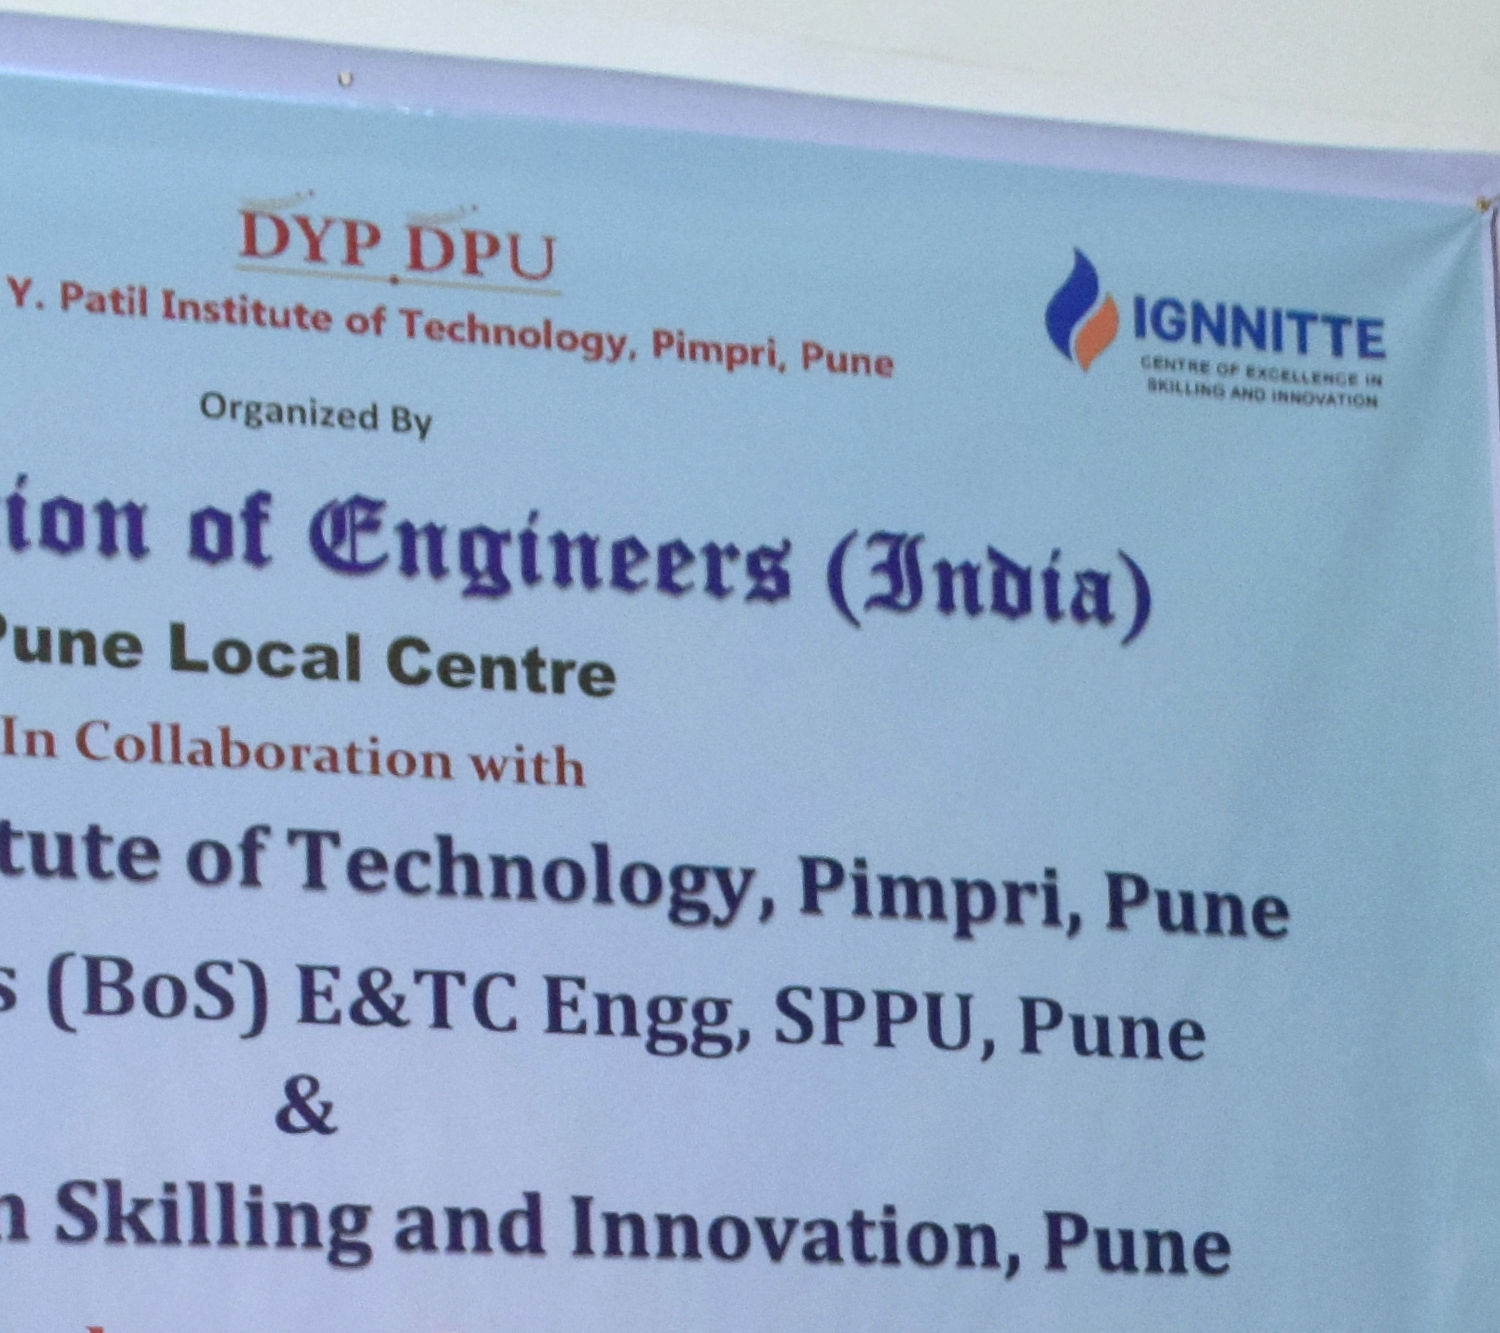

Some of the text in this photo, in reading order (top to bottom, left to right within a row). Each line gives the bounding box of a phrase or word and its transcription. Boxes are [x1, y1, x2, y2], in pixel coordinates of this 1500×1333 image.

[239, 209, 557, 281] DYP DPU
[7, 270, 46, 312] Y.
[59, 281, 149, 318] Patil
[161, 286, 331, 334] Institute
[345, 301, 388, 339] of
[399, 306, 639, 366] Technology,
[652, 329, 788, 375] Pimpri,
[802, 341, 895, 380] Pune
[1134, 294, 1386, 359] IGNNITTE
[1141, 355, 1382, 386] CENTRE OF EXCELLENCE IN
[1148, 377, 1378, 408] SKILLING AND INNOVATION
[199, 390, 433, 441] Organized By
[188, 490, 271, 569] of
[309, 494, 793, 599] Engineers
[826, 530, 1154, 645] (India)
[169, 618, 362, 680] Local
[386, 634, 618, 698] Centre
[74, 720, 454, 779] Collaboration
[468, 744, 587, 790] with
[186, 825, 271, 888] of
[288, 828, 776, 926] Technology,
[797, 853, 1084, 937] Pimpri,
[1106, 871, 1292, 940] Pune
[45, 948, 269, 1038] (BoS)
[296, 962, 519, 1034] E&TC
[542, 973, 752, 1058] Engg,
[774, 984, 998, 1063] SPPU,
[1018, 994, 1206, 1063] Pune
[274, 1074, 339, 1136] &
[54, 1176, 373, 1267] Skilling
[394, 1194, 546, 1258] and
[568, 1192, 1022, 1280] Innovation,
[1042, 1210, 1233, 1277] Pune
